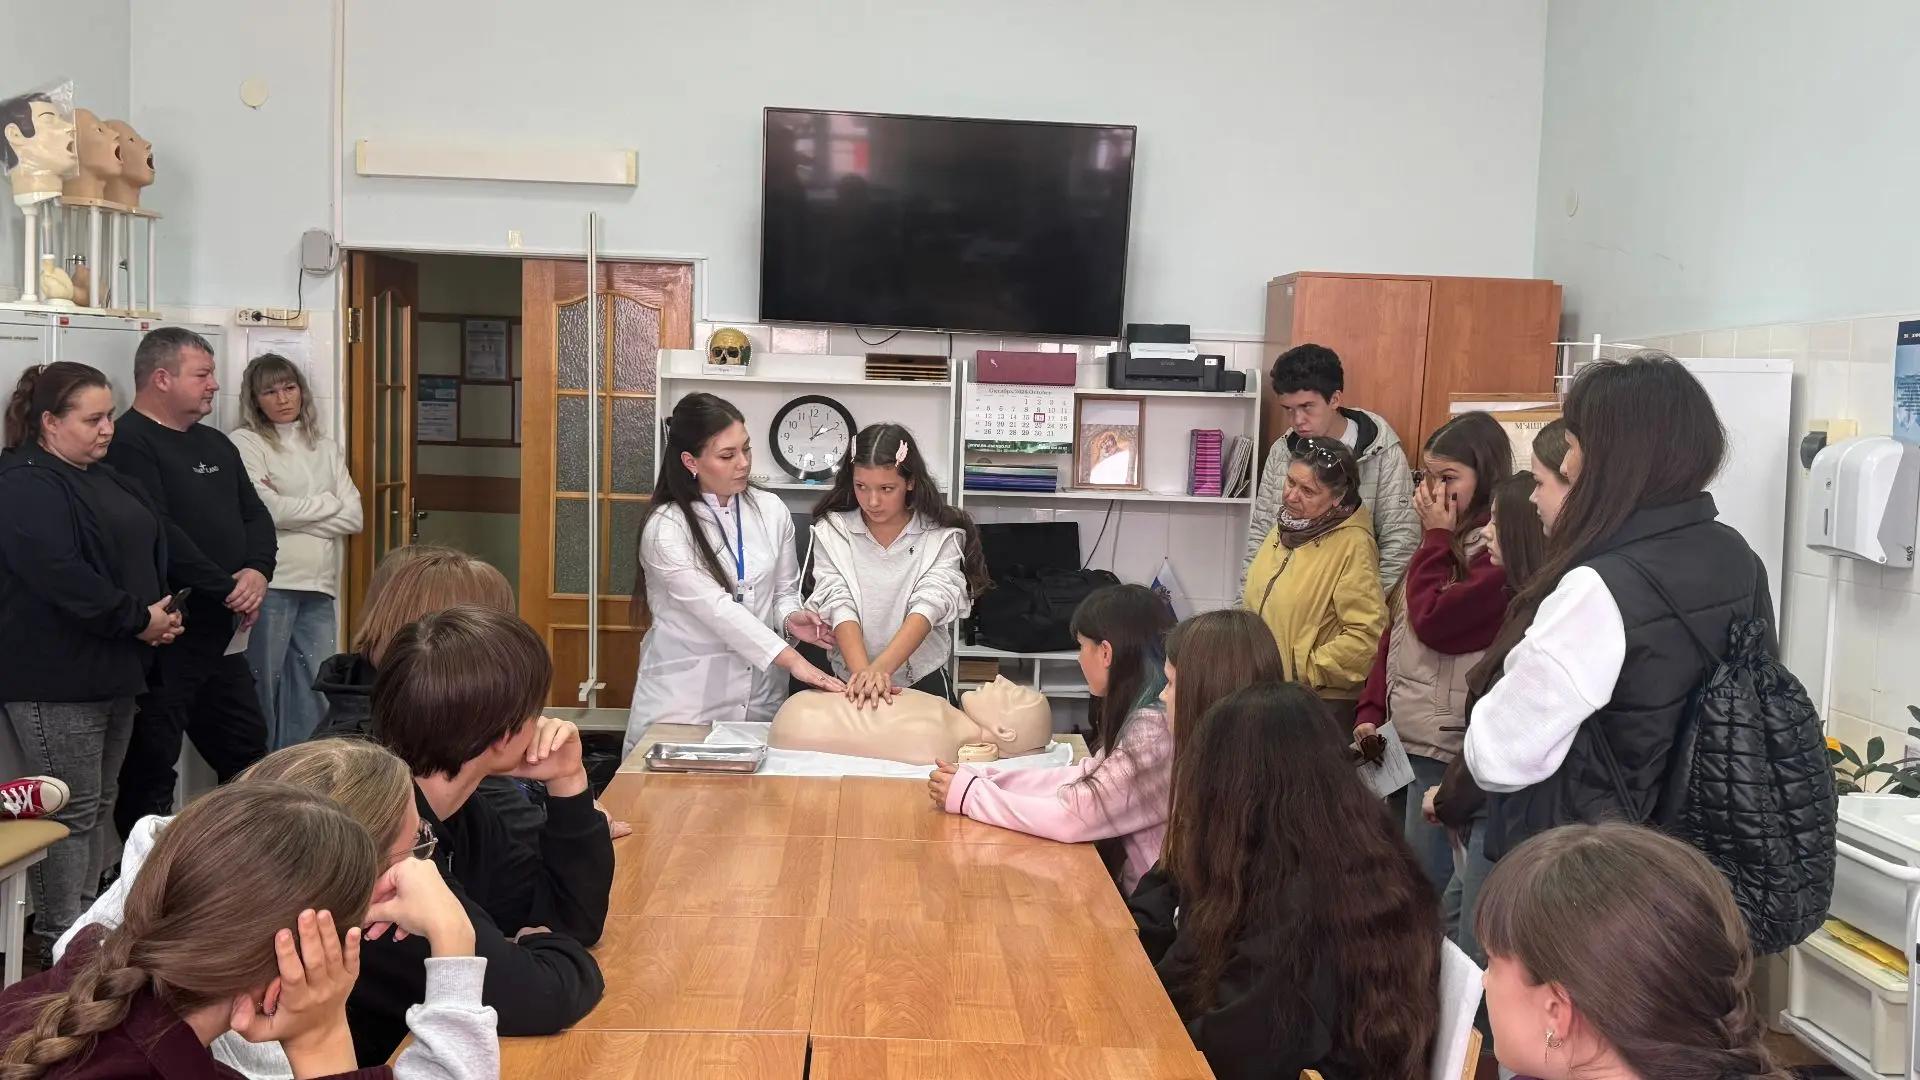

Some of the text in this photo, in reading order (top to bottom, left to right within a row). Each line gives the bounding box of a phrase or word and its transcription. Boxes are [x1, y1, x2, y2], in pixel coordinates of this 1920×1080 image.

[798, 412, 805, 420] 11
[811, 409, 818, 417] 12
[789, 421, 797, 429] 10
[834, 422, 840, 430] 2
[788, 445, 793, 453] 8
